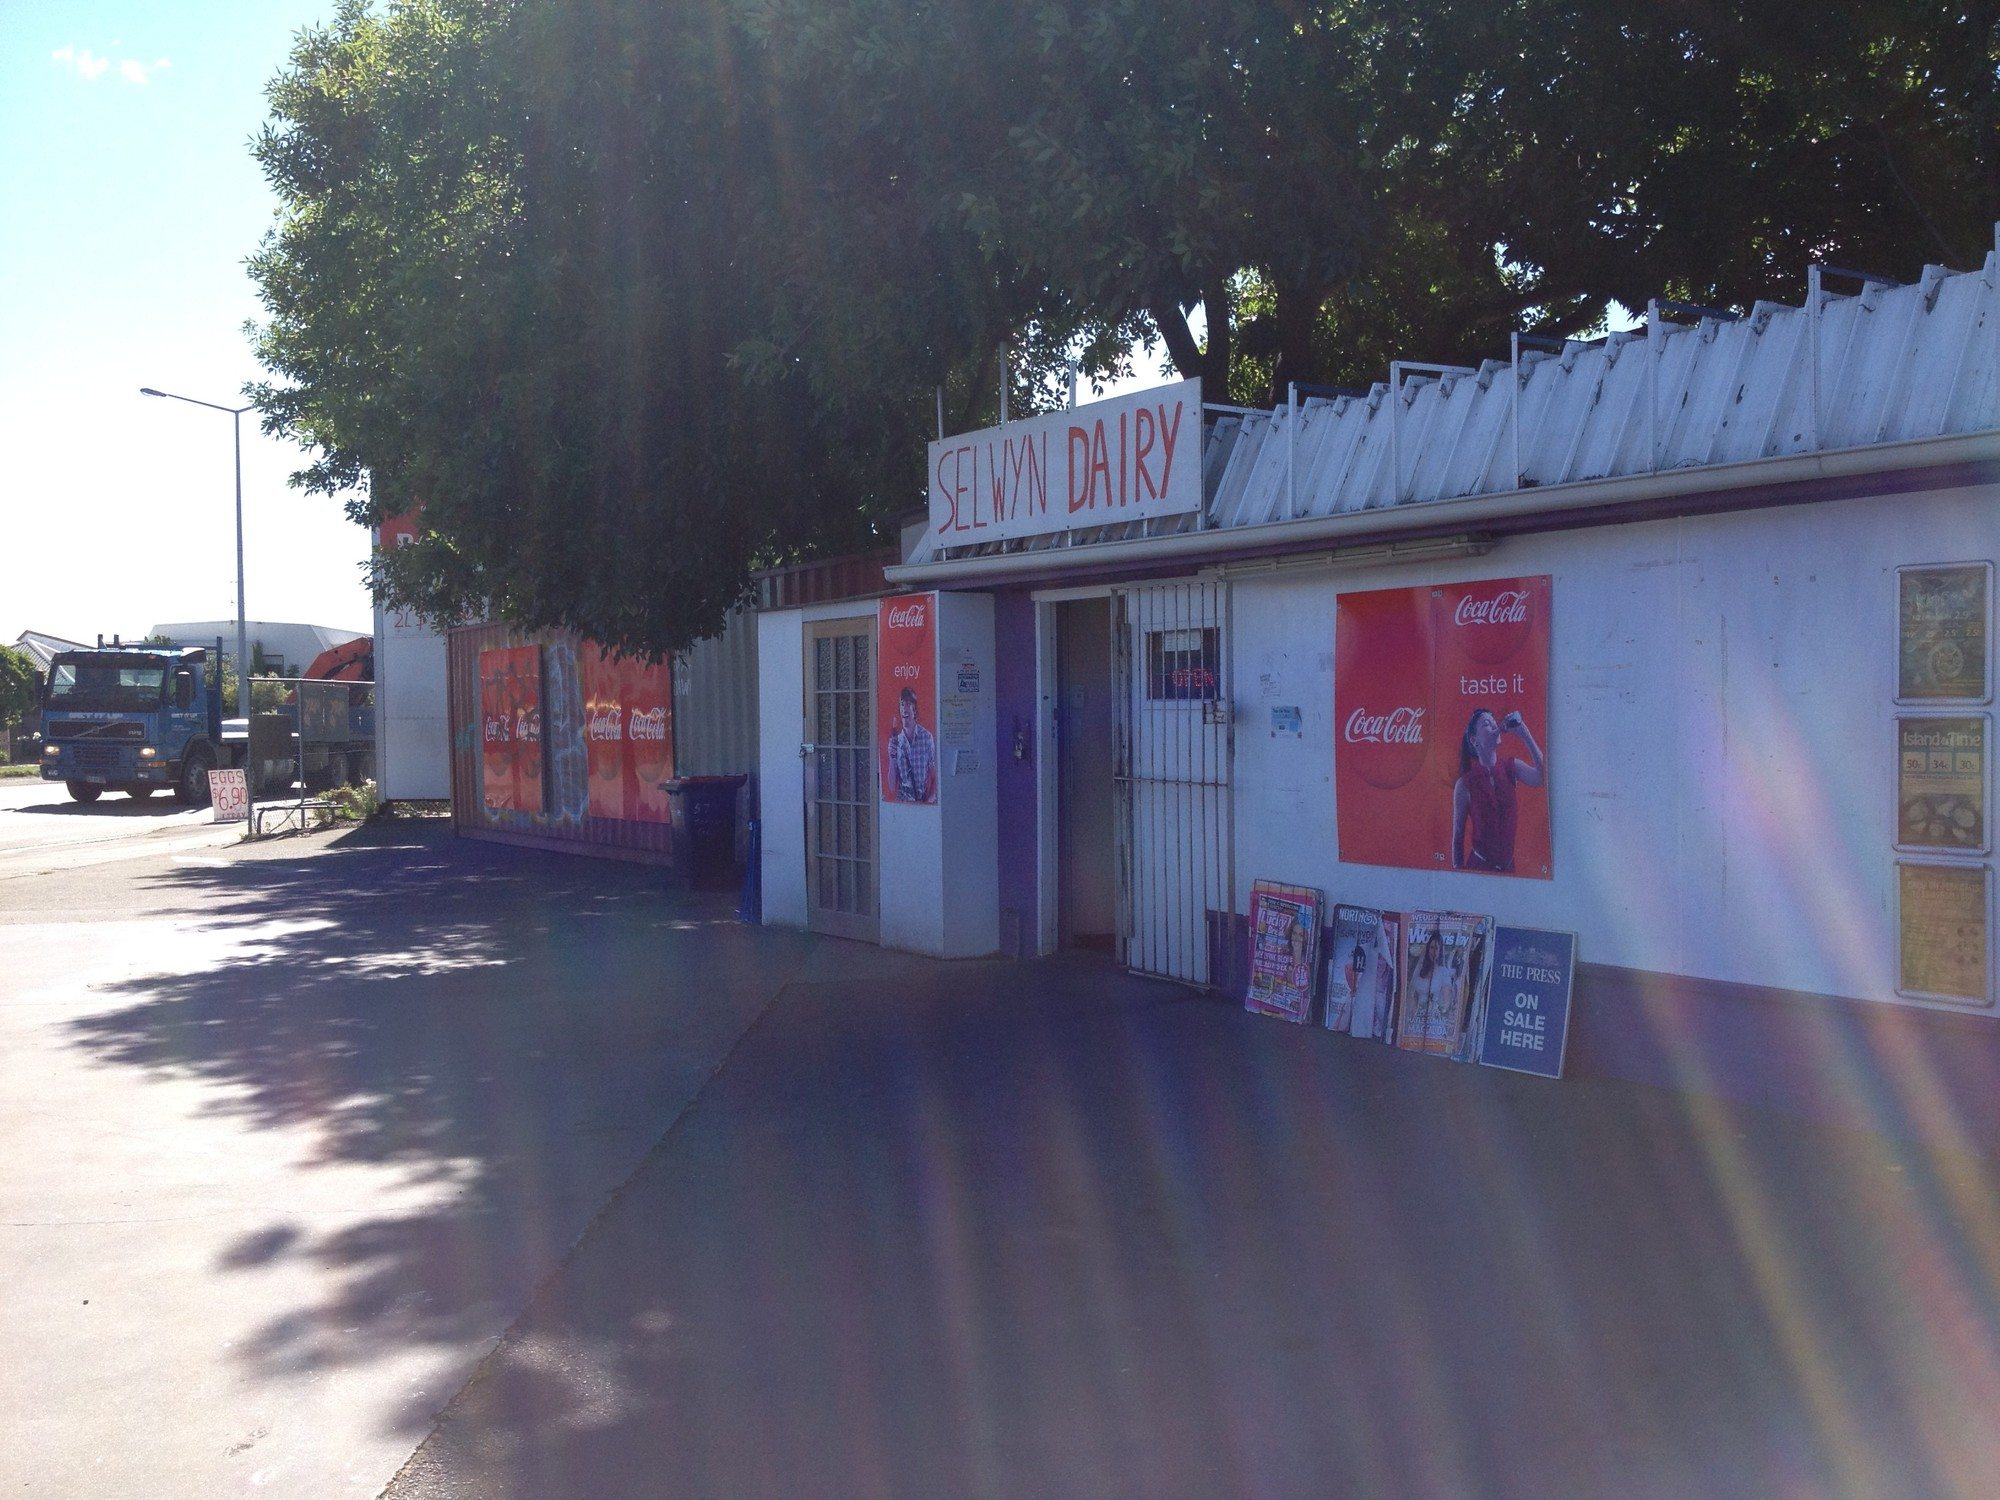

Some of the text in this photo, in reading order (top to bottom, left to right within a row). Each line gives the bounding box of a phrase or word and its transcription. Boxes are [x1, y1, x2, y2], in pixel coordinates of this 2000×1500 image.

[938, 401, 1183, 534] SELWYN DAIRY
[889, 604, 926, 629] Coca-Cola
[1454, 590, 1531, 626] Coca-Cola
[894, 662, 921, 680] enjoy
[1460, 673, 1525, 695] taste it
[1344, 707, 1427, 744] Coca-Cola
[1903, 731, 1940, 747] Island
[210, 771, 244, 785] EGGS
[212, 787, 248, 811] $6.90
[1500, 964, 1562, 985] THE PRESS
[1514, 992, 1539, 1011] ON
[1503, 1010, 1546, 1032] SALE
[1500, 1029, 1545, 1052] HERE
